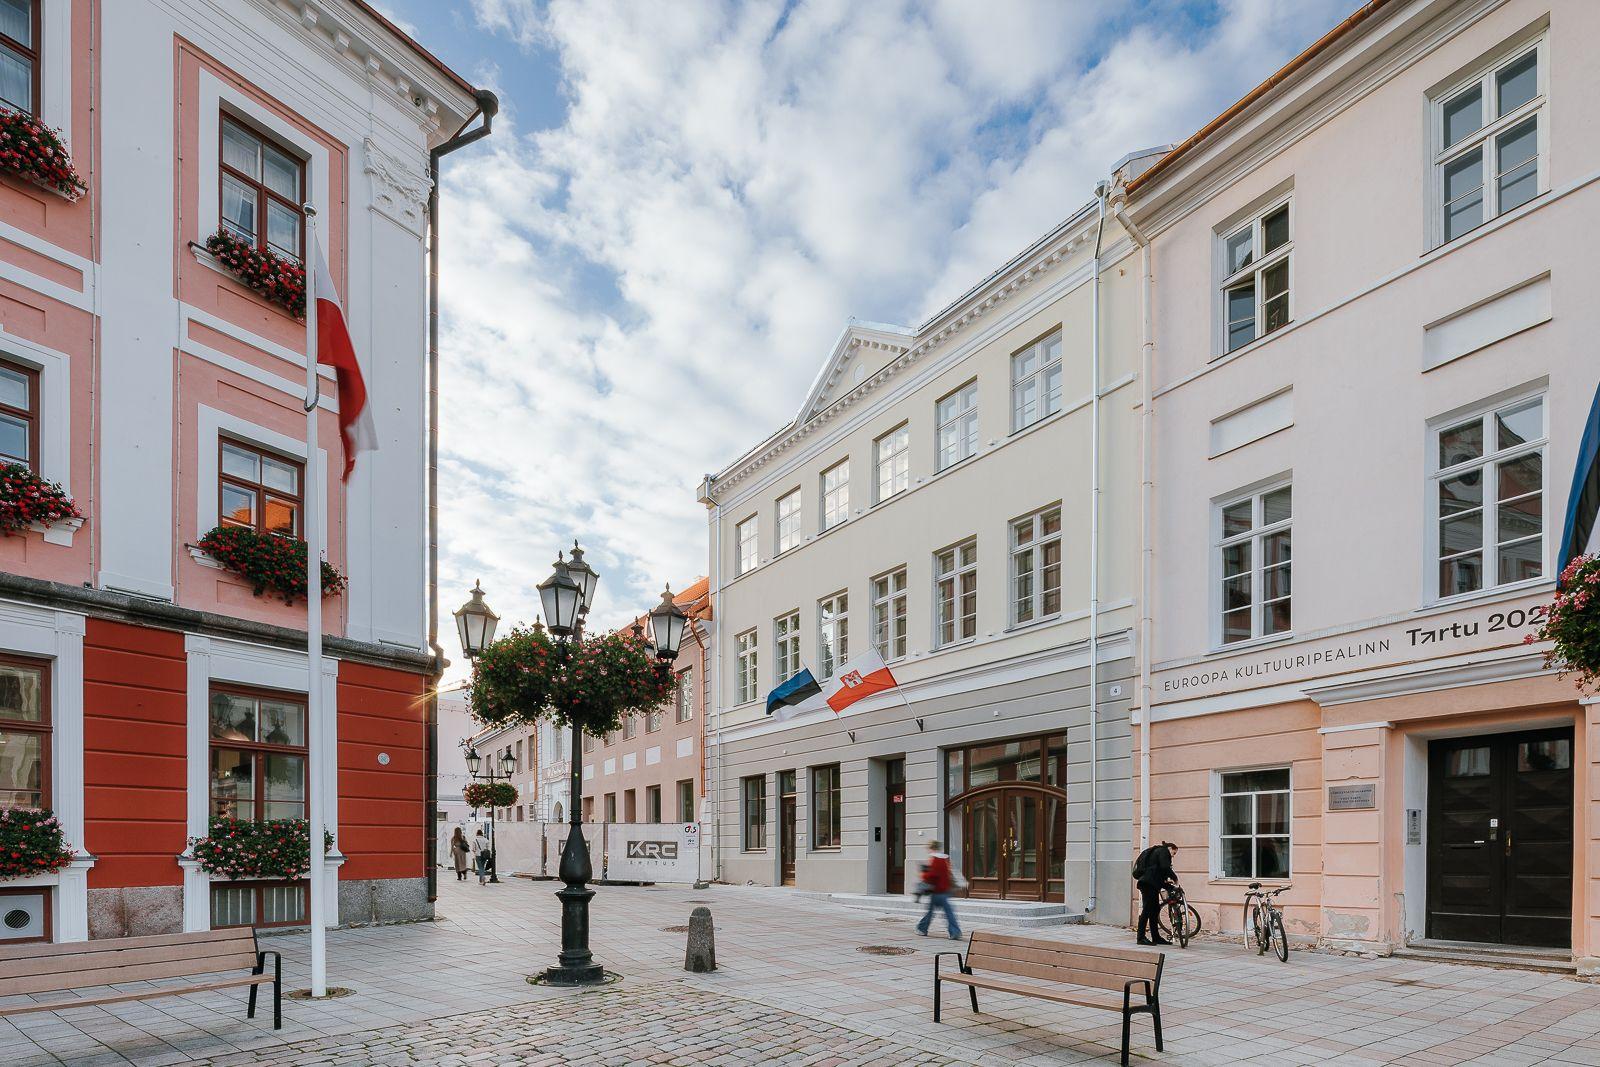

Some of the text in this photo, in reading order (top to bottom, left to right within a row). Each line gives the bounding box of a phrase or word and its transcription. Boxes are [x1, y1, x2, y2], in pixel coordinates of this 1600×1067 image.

[1487, 605, 1550, 633] 202
[1164, 639, 1390, 692] EUROOPA KULTUURIPEALINN
[629, 840, 676, 859] KRC
